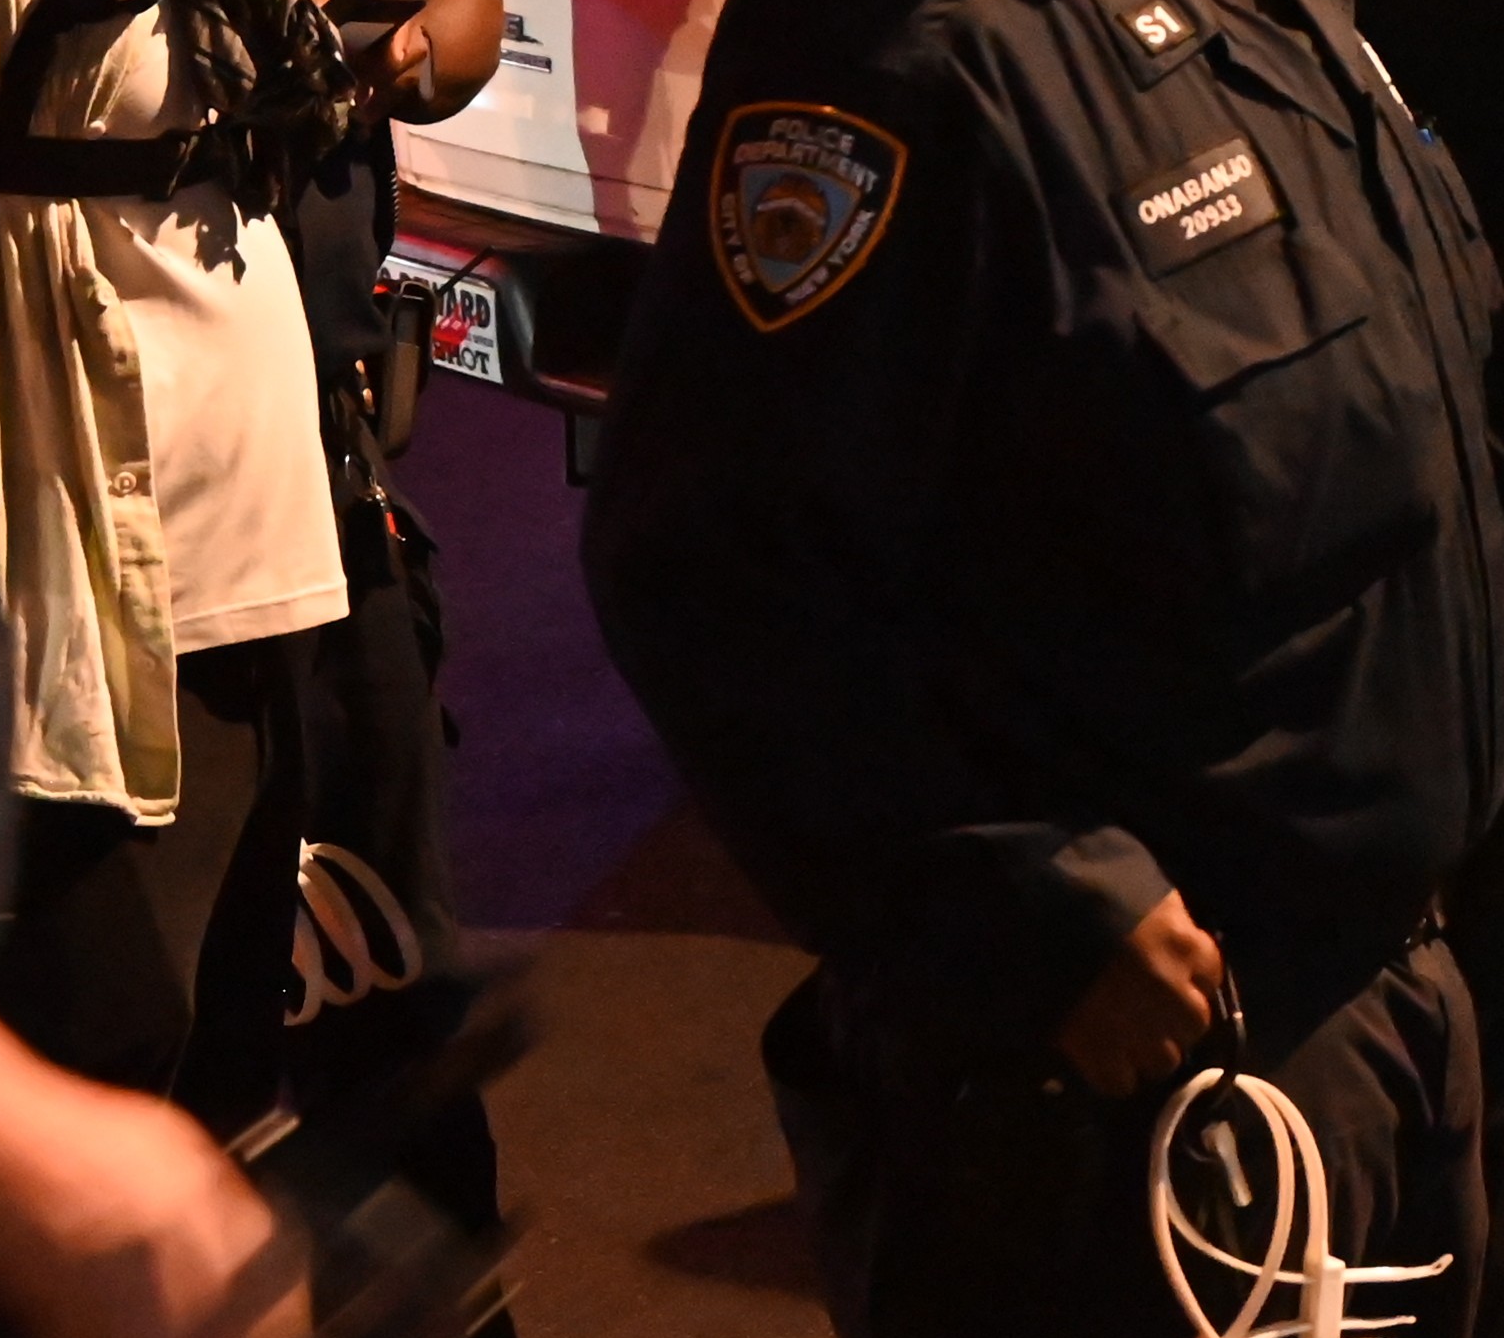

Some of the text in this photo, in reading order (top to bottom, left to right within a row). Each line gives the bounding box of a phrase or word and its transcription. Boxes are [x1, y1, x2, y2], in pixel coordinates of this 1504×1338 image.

[1134, 5, 1182, 45] S1
[767, 117, 856, 156] POLICE
[733, 140, 880, 194] DEPARTMENT
[1137, 153, 1254, 226] ONABANJO
[1179, 193, 1243, 241] 20933
